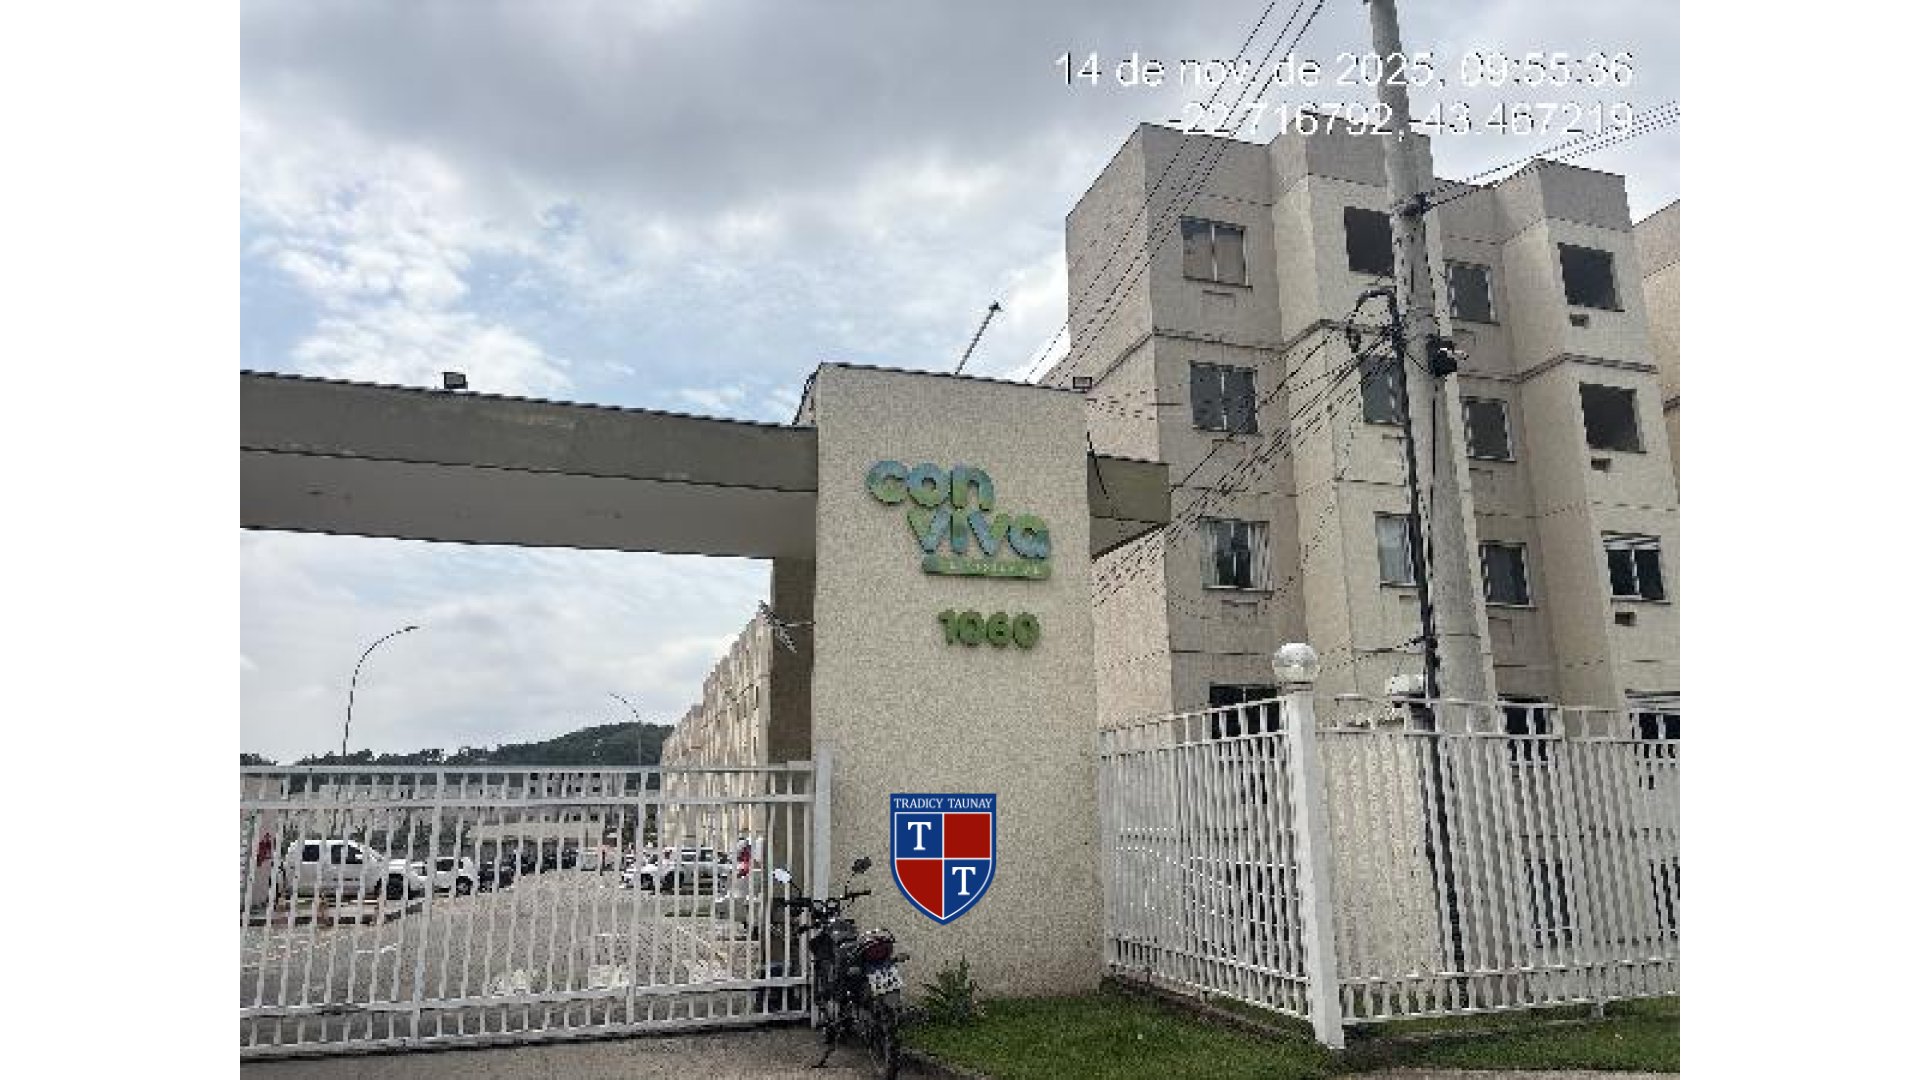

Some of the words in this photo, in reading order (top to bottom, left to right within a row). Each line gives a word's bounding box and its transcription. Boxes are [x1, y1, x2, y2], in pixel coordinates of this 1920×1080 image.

[865, 460, 995, 512] con
[906, 506, 1051, 560] viva
[938, 609, 1041, 649] 1060
